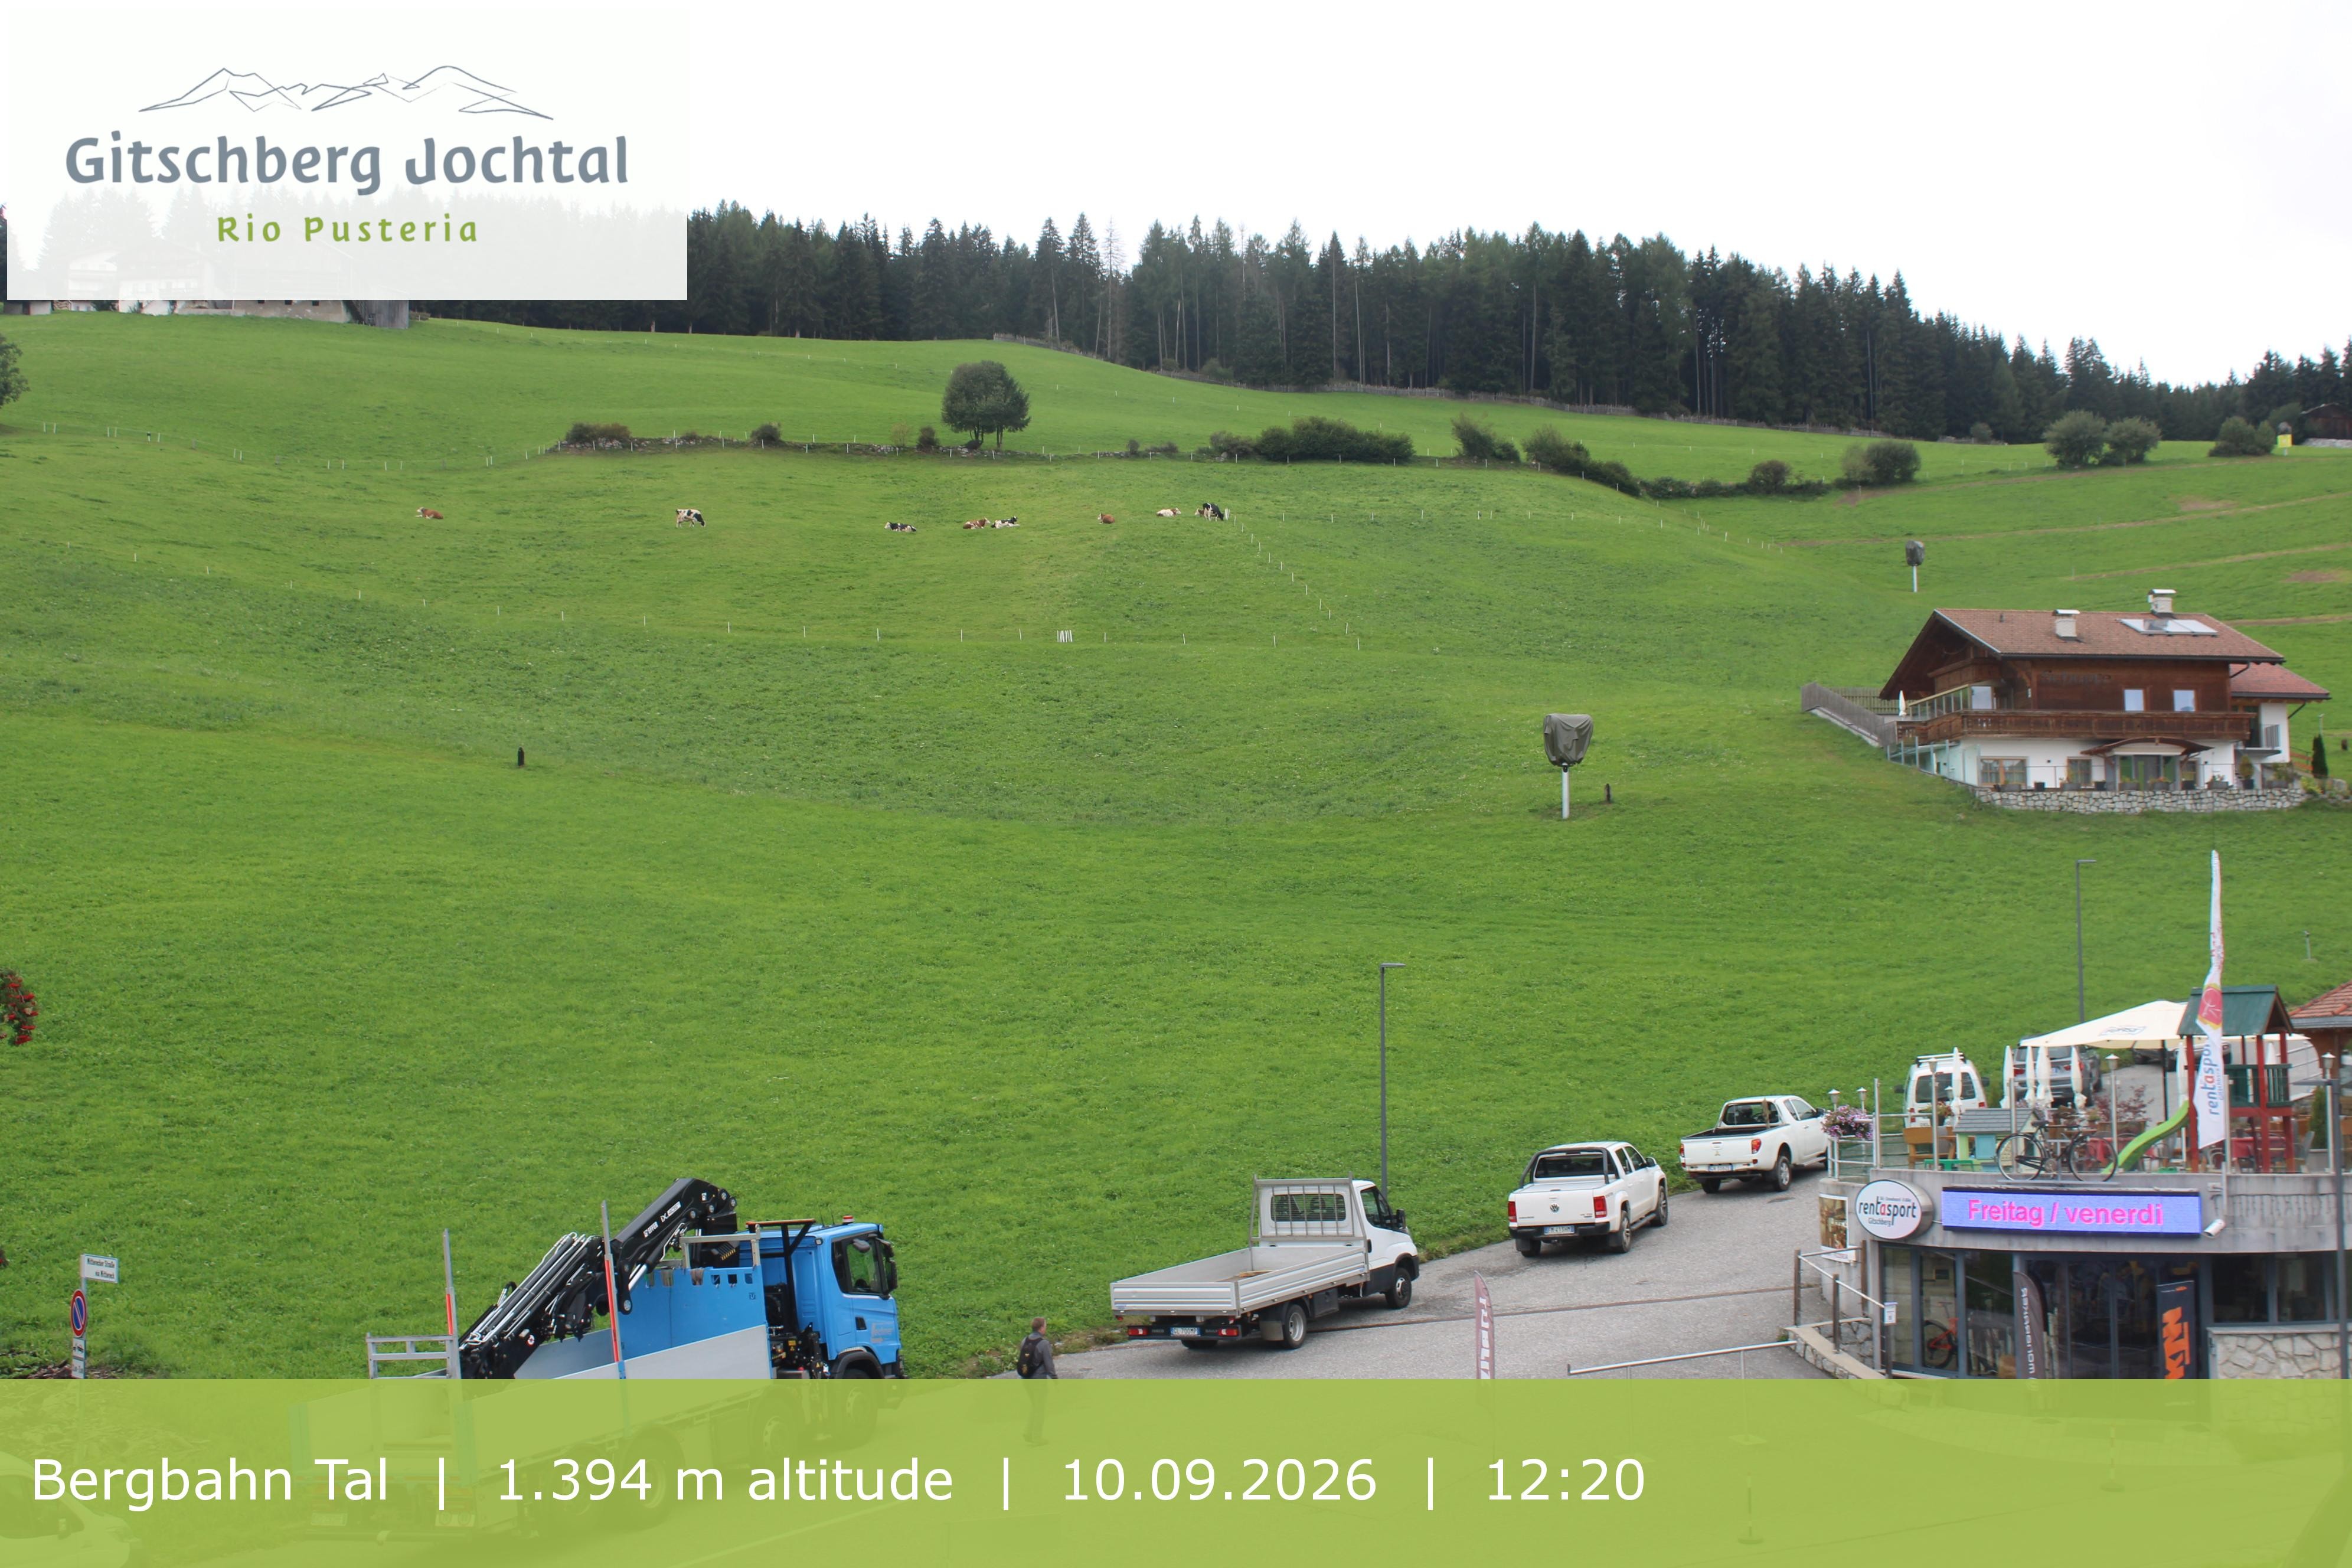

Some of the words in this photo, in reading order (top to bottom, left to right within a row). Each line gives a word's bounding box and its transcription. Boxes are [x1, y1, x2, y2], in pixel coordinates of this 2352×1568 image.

[1858, 1195, 1917, 1226] rentasport
[1868, 1217, 1892, 1227] Gitschberg
[1969, 1199, 2043, 1227] Freitag
[2065, 1203, 2164, 1225] venerdi
[2162, 1306, 2191, 1383] KTM
